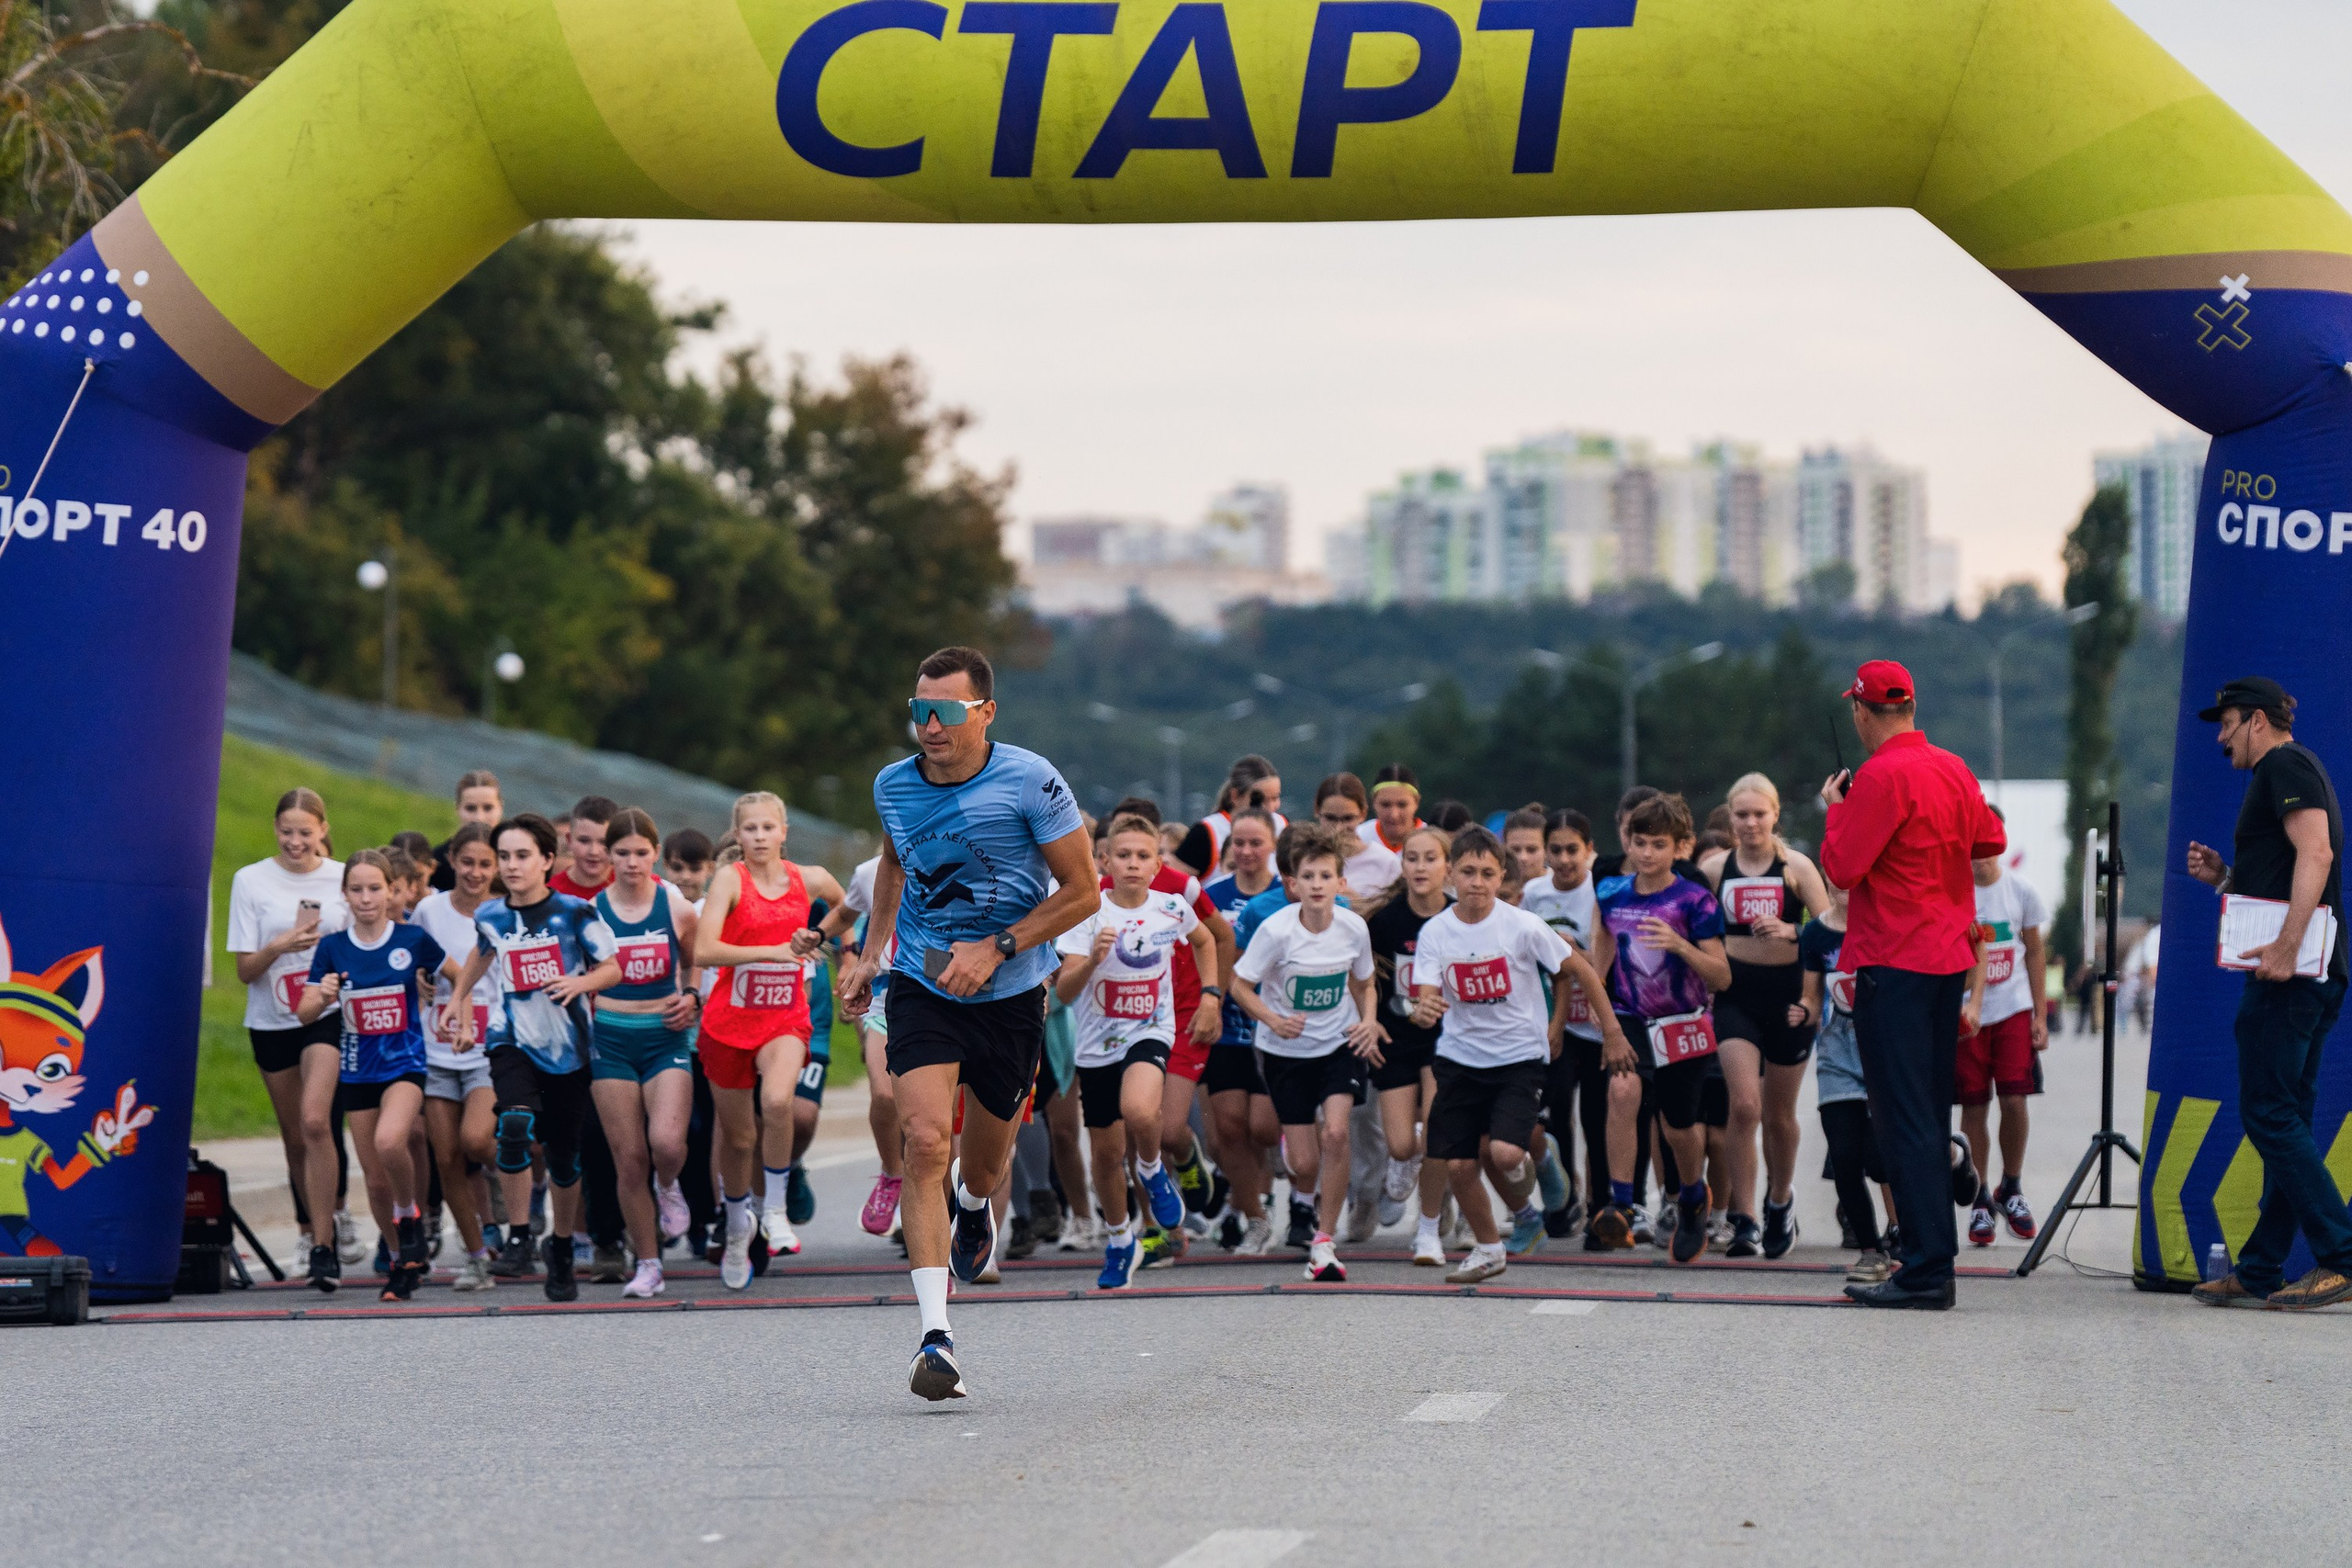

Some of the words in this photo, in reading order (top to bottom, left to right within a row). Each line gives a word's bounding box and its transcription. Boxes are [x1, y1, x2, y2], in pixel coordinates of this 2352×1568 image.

[775, 0, 1637, 179] СТАРТ
[2222, 468, 2277, 501] PRO
[141, 507, 208, 552] 40
[1741, 898, 1779, 919] 2908
[520, 960, 560, 985] 1586
[624, 958, 666, 980] 4944
[1473, 964, 1490, 976] ОЛЕГ
[1986, 960, 2011, 980] 068
[1464, 972, 1507, 996] 5114
[752, 985, 793, 1006] 2123
[1113, 994, 1155, 1015] 4499
[1303, 987, 1340, 1007] 5261
[362, 1008, 401, 1031] 2557
[1678, 1032, 1709, 1055] 516
